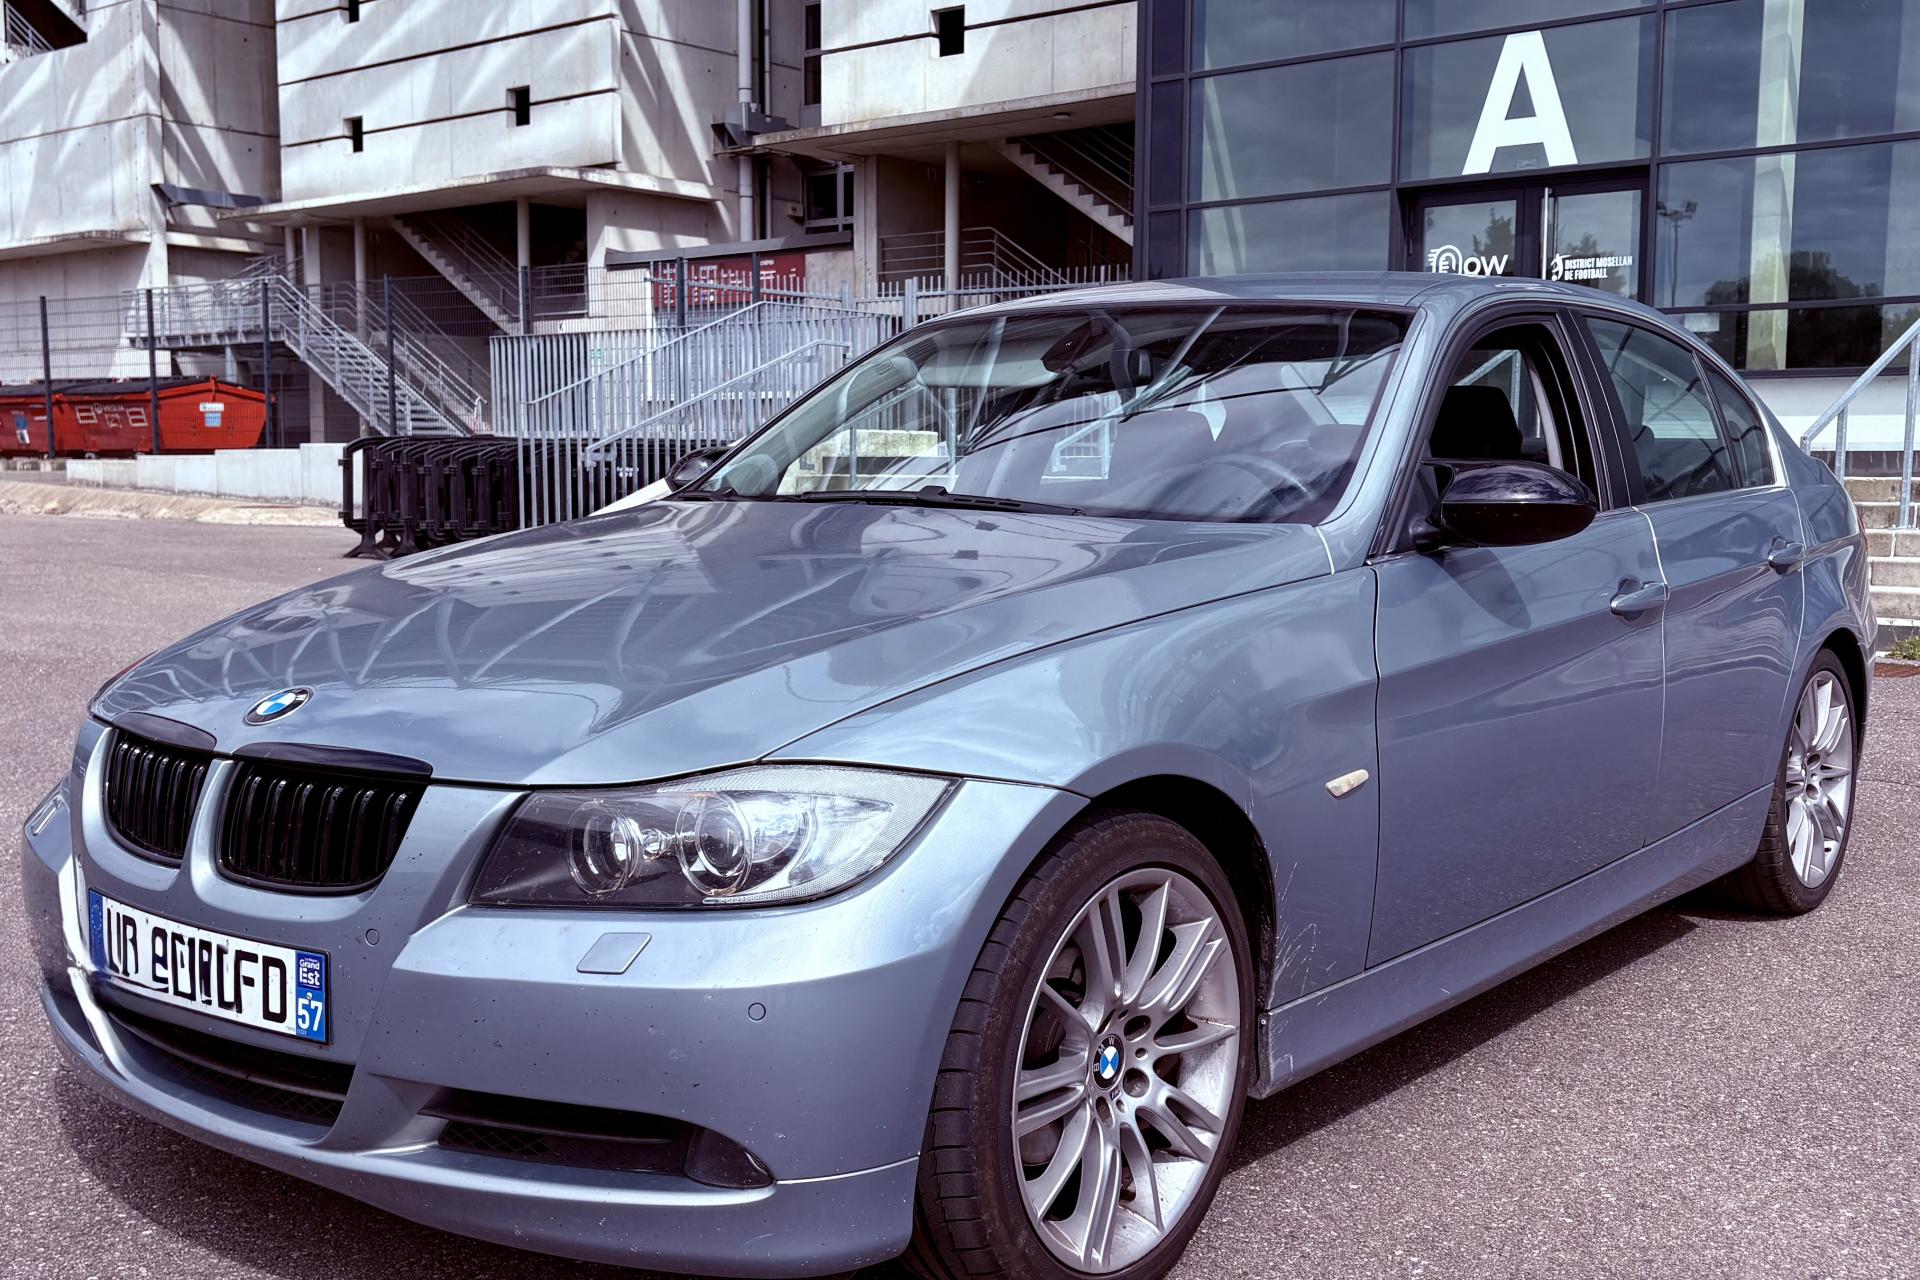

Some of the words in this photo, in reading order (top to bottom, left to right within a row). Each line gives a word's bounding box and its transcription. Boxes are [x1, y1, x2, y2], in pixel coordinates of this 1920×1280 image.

[1462, 30, 1578, 175] A
[1564, 258, 1595, 270] DISTRICT
[1595, 255, 1633, 268] MOSELLAN
[1564, 270, 1574, 281] DE
[1574, 268, 1608, 280] FOOTBALL
[299, 958, 320, 970] Grand
[299, 966, 320, 986] Est
[297, 997, 323, 1032] 57
